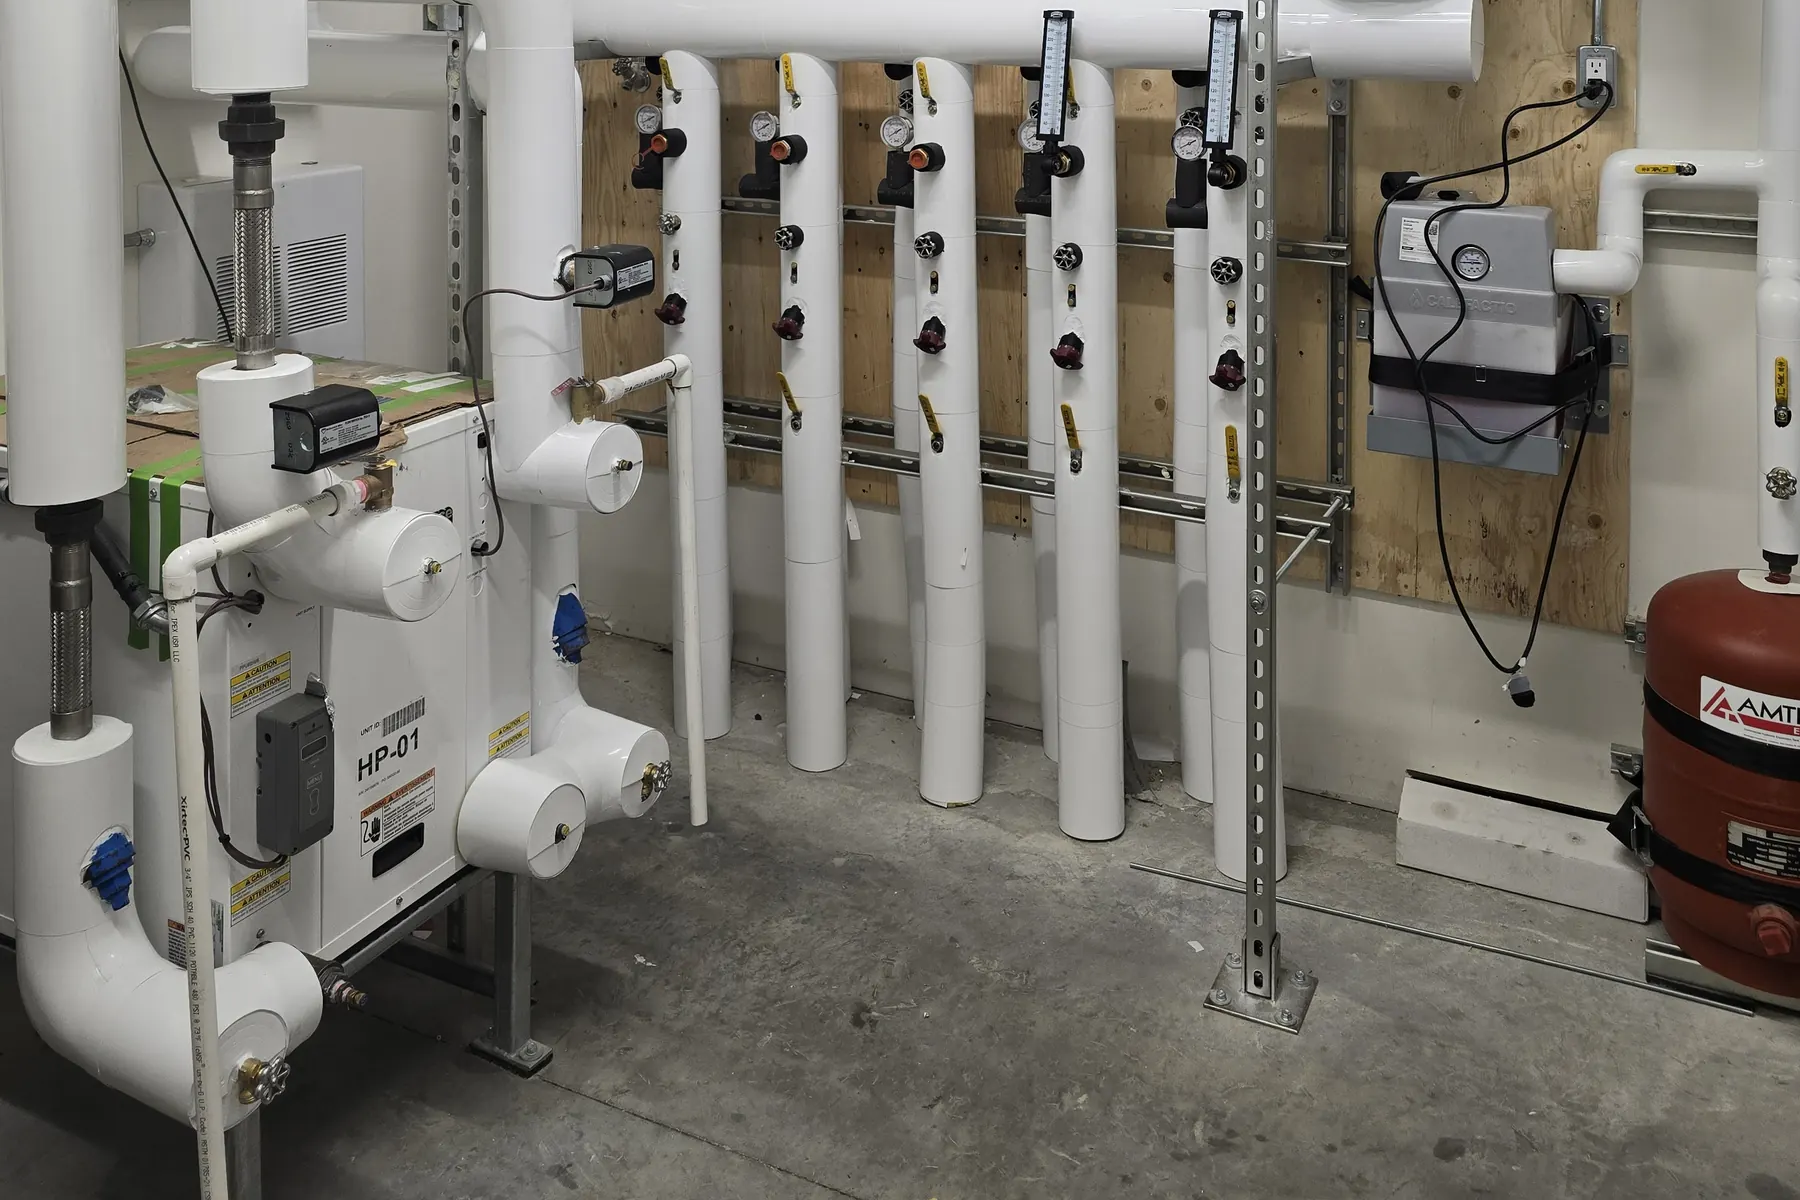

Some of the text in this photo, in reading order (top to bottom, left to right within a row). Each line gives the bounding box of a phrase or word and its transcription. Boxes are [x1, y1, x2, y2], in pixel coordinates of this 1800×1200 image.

[251, 659, 277, 677] CAUTION
[248, 675, 280, 696] ATTENTION
[1737, 697, 1800, 725] AMT
[360, 724, 373, 736] UNIT
[358, 726, 418, 782] HP-01
[363, 801, 384, 817] WARNING
[249, 880, 280, 903] ATTENTION
[190, 960, 198, 986] POTABLE
